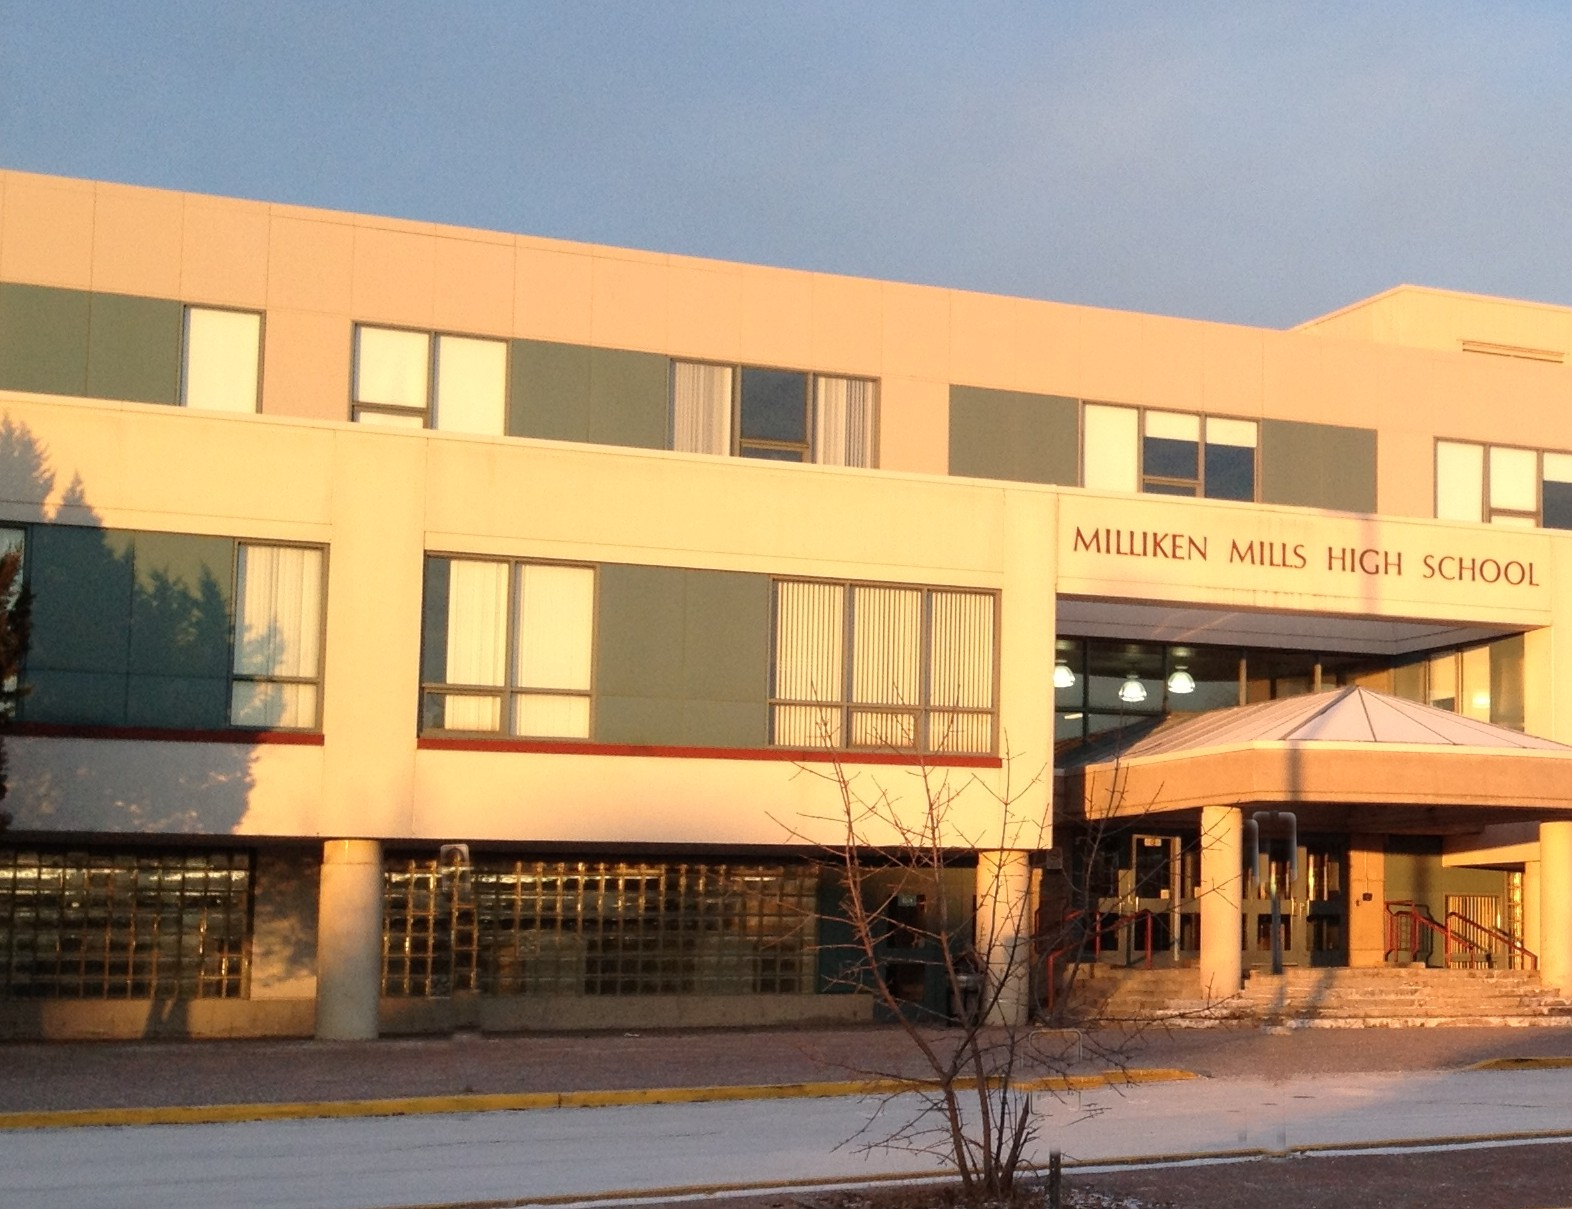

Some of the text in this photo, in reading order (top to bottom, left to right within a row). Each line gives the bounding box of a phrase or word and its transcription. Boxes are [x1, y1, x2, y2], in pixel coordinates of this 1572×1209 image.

[1072, 525, 1540, 587] MILLIKEN MILLS HIGH SCHOOL
